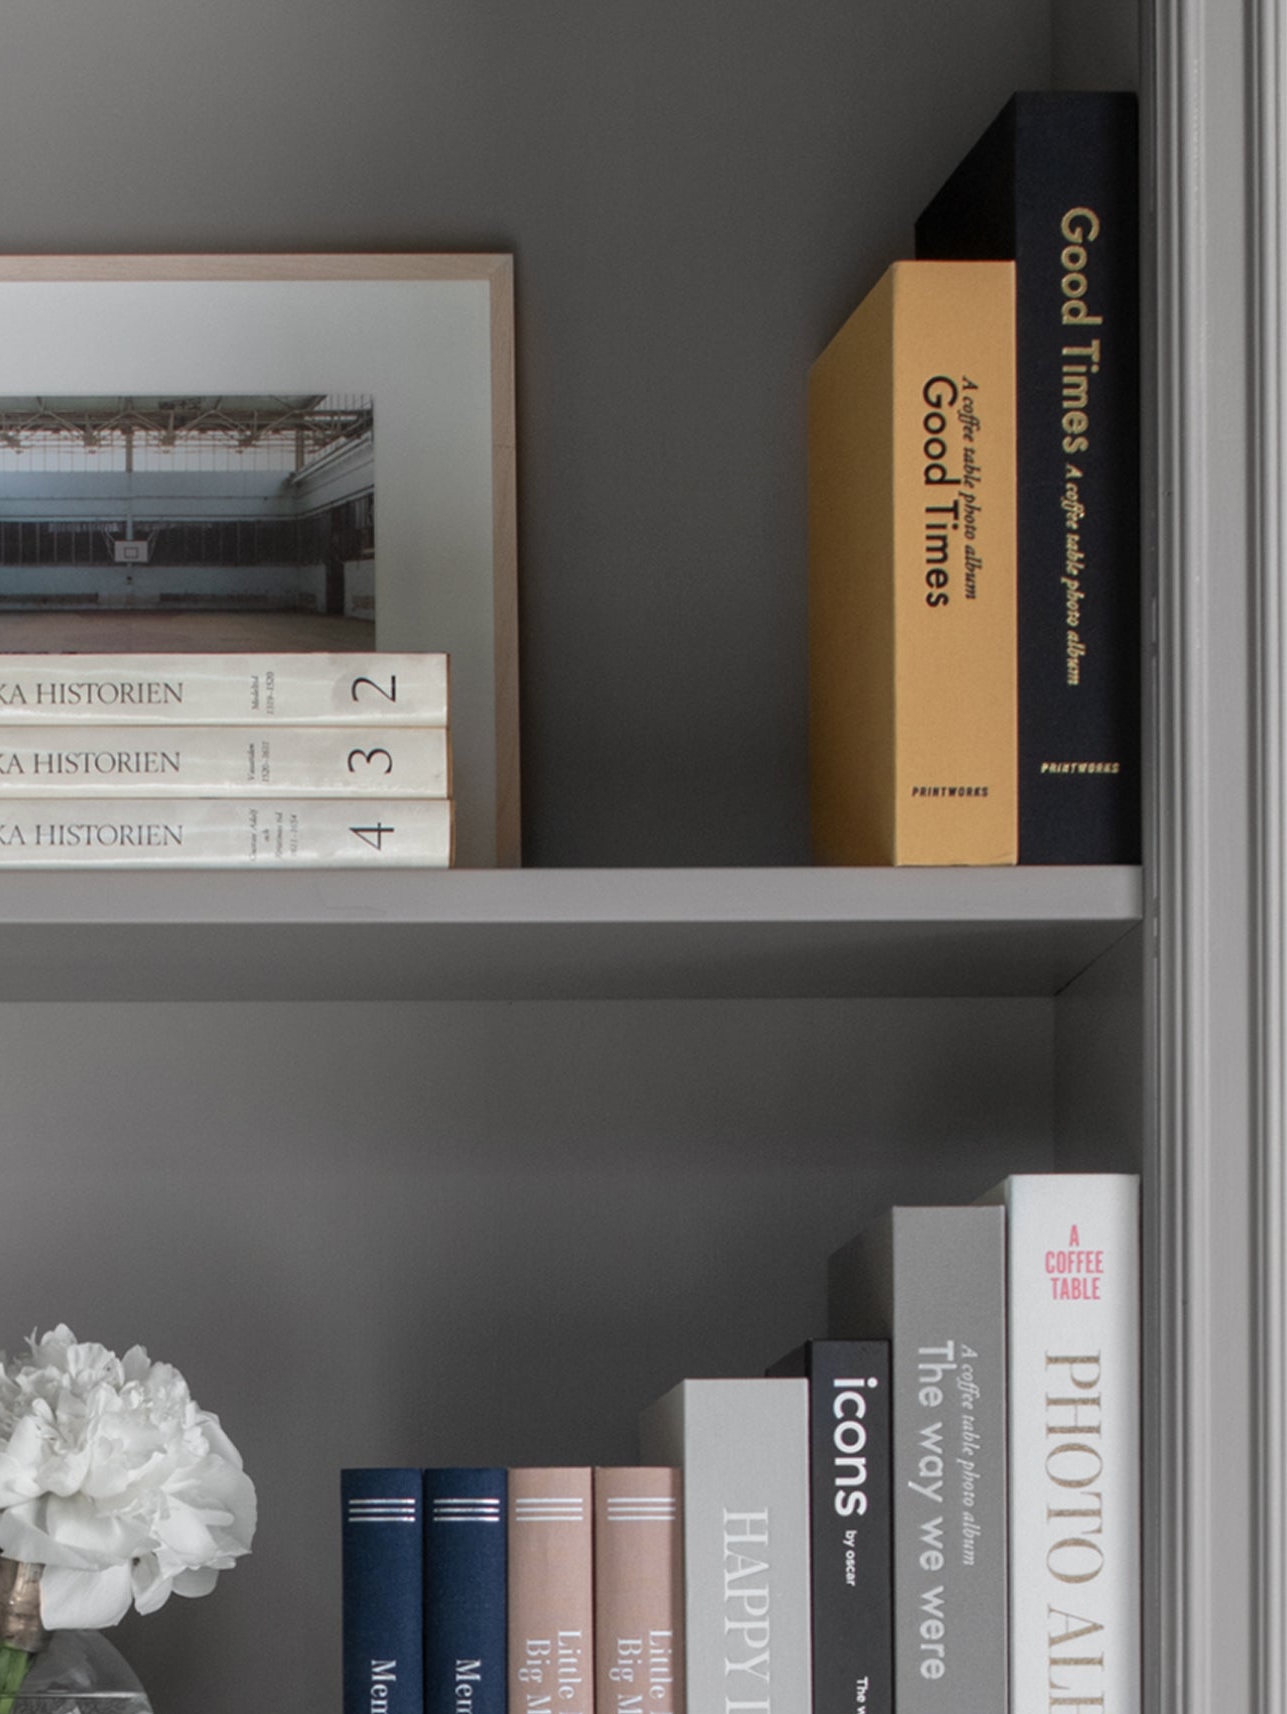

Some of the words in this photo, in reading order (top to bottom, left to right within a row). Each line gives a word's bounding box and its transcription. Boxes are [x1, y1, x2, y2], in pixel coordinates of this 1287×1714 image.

[1061, 207, 1102, 324] Good
[962, 376, 978, 390] A
[1061, 340, 1100, 453] Times
[923, 376, 957, 485] Good
[958, 396, 980, 442] coffee
[964, 447, 981, 488] table
[1066, 464, 1082, 478] A
[958, 491, 981, 540] photo
[1061, 483, 1085, 529] coffee
[925, 499, 957, 607] Times
[965, 545, 982, 599] album
[1066, 534, 1084, 575] table
[1061, 577, 1084, 627] photo
[1067, 630, 1085, 685] album
[36, 682, 184, 704] HISTORIEN
[352, 675, 396, 702] 2
[34, 751, 181, 774] HISTORIEN
[348, 749, 392, 773] 3
[36, 824, 182, 845] HISTORIEN
[349, 823, 394, 850] 4
[1069, 1225, 1079, 1246] A
[1045, 1251, 1105, 1274] COFFEE
[1052, 1277, 1102, 1301] TABLE
[918, 1340, 957, 1407] The
[962, 1345, 977, 1357] A
[956, 1364, 980, 1409] coffee
[833, 1377, 878, 1516] icons
[962, 1415, 980, 1455] table
[908, 1422, 943, 1502] way
[956, 1459, 980, 1507] photo
[1046, 1352, 1103, 1583] PHOTO
[843, 1530, 857, 1547] by
[919, 1517, 944, 1570] we
[963, 1512, 981, 1565] album
[846, 1550, 855, 1586] oscar
[723, 1509, 772, 1683] HAPPY
[920, 1586, 945, 1679] were
[518, 1638, 551, 1682] Big
[558, 1630, 582, 1698] Little
[609, 1637, 643, 1682] Big
[649, 1629, 673, 1698] Little
[857, 1677, 868, 1703] The
